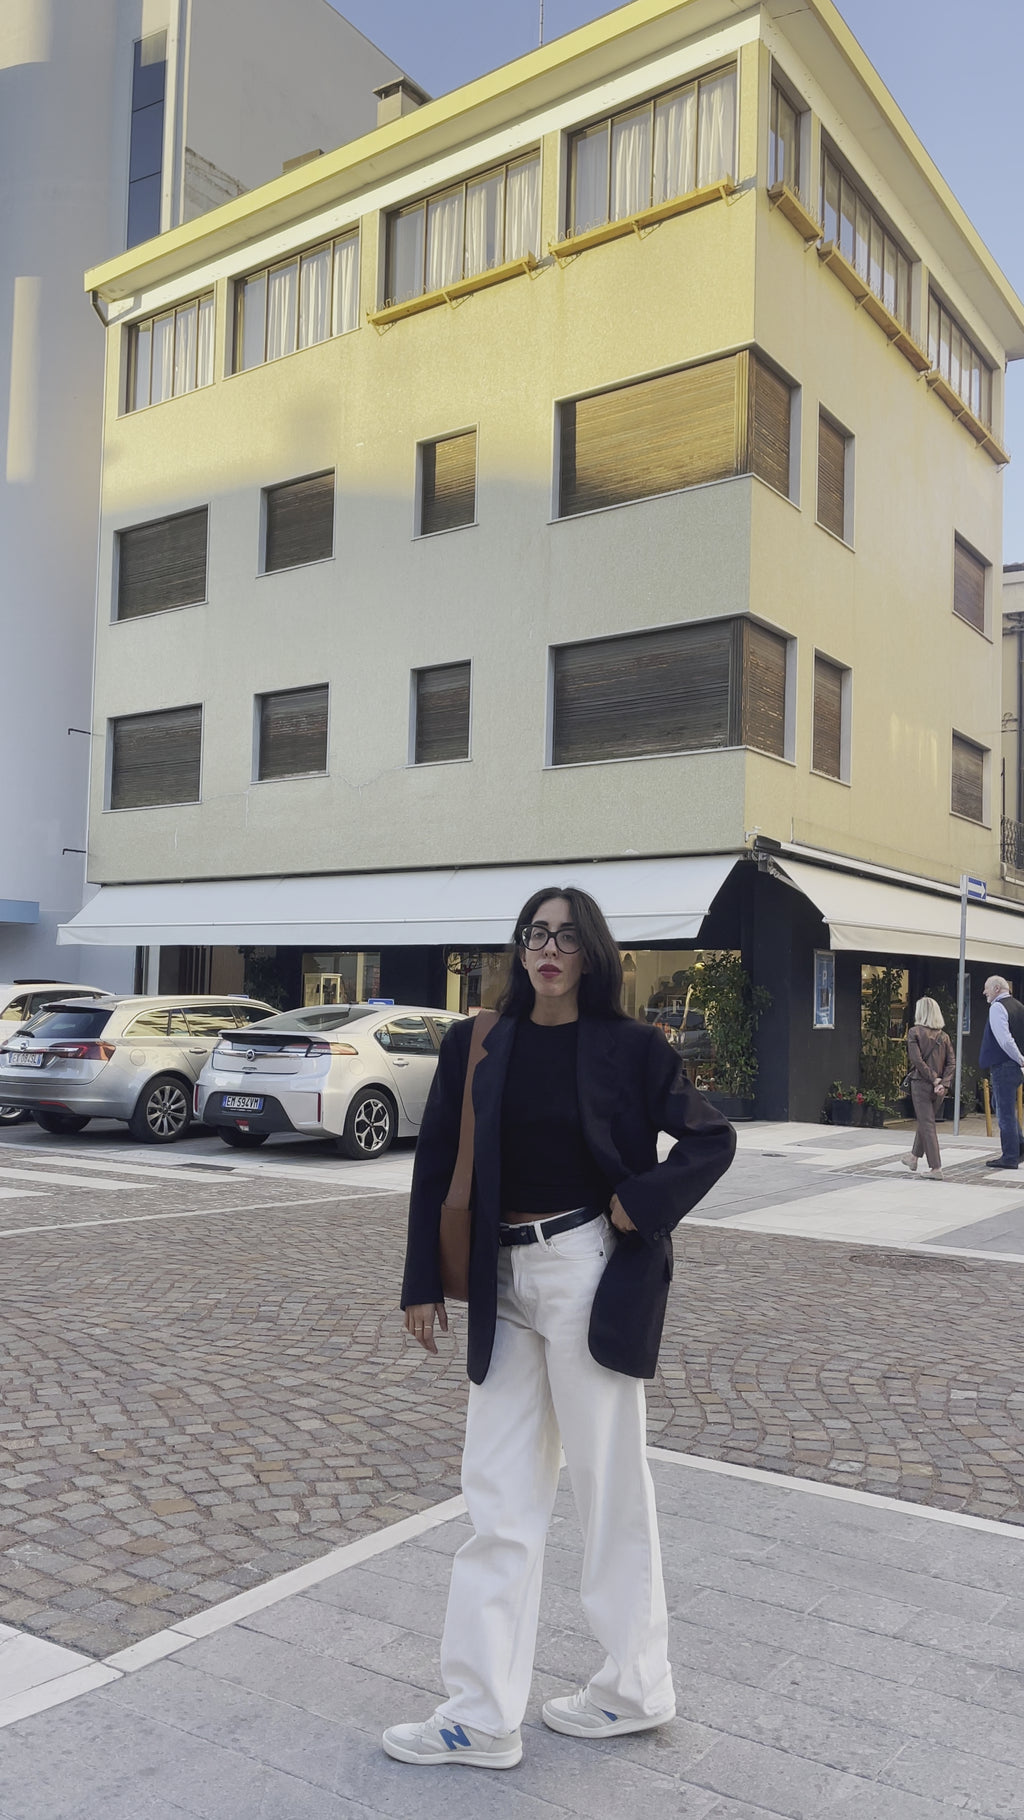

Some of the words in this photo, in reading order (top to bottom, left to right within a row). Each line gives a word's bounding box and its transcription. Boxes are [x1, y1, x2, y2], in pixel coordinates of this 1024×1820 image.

[672, 999, 683, 1014] F
[226, 1096, 236, 1107] EM
[236, 1097, 259, 1108] 594VM
[439, 1724, 471, 1750] N
